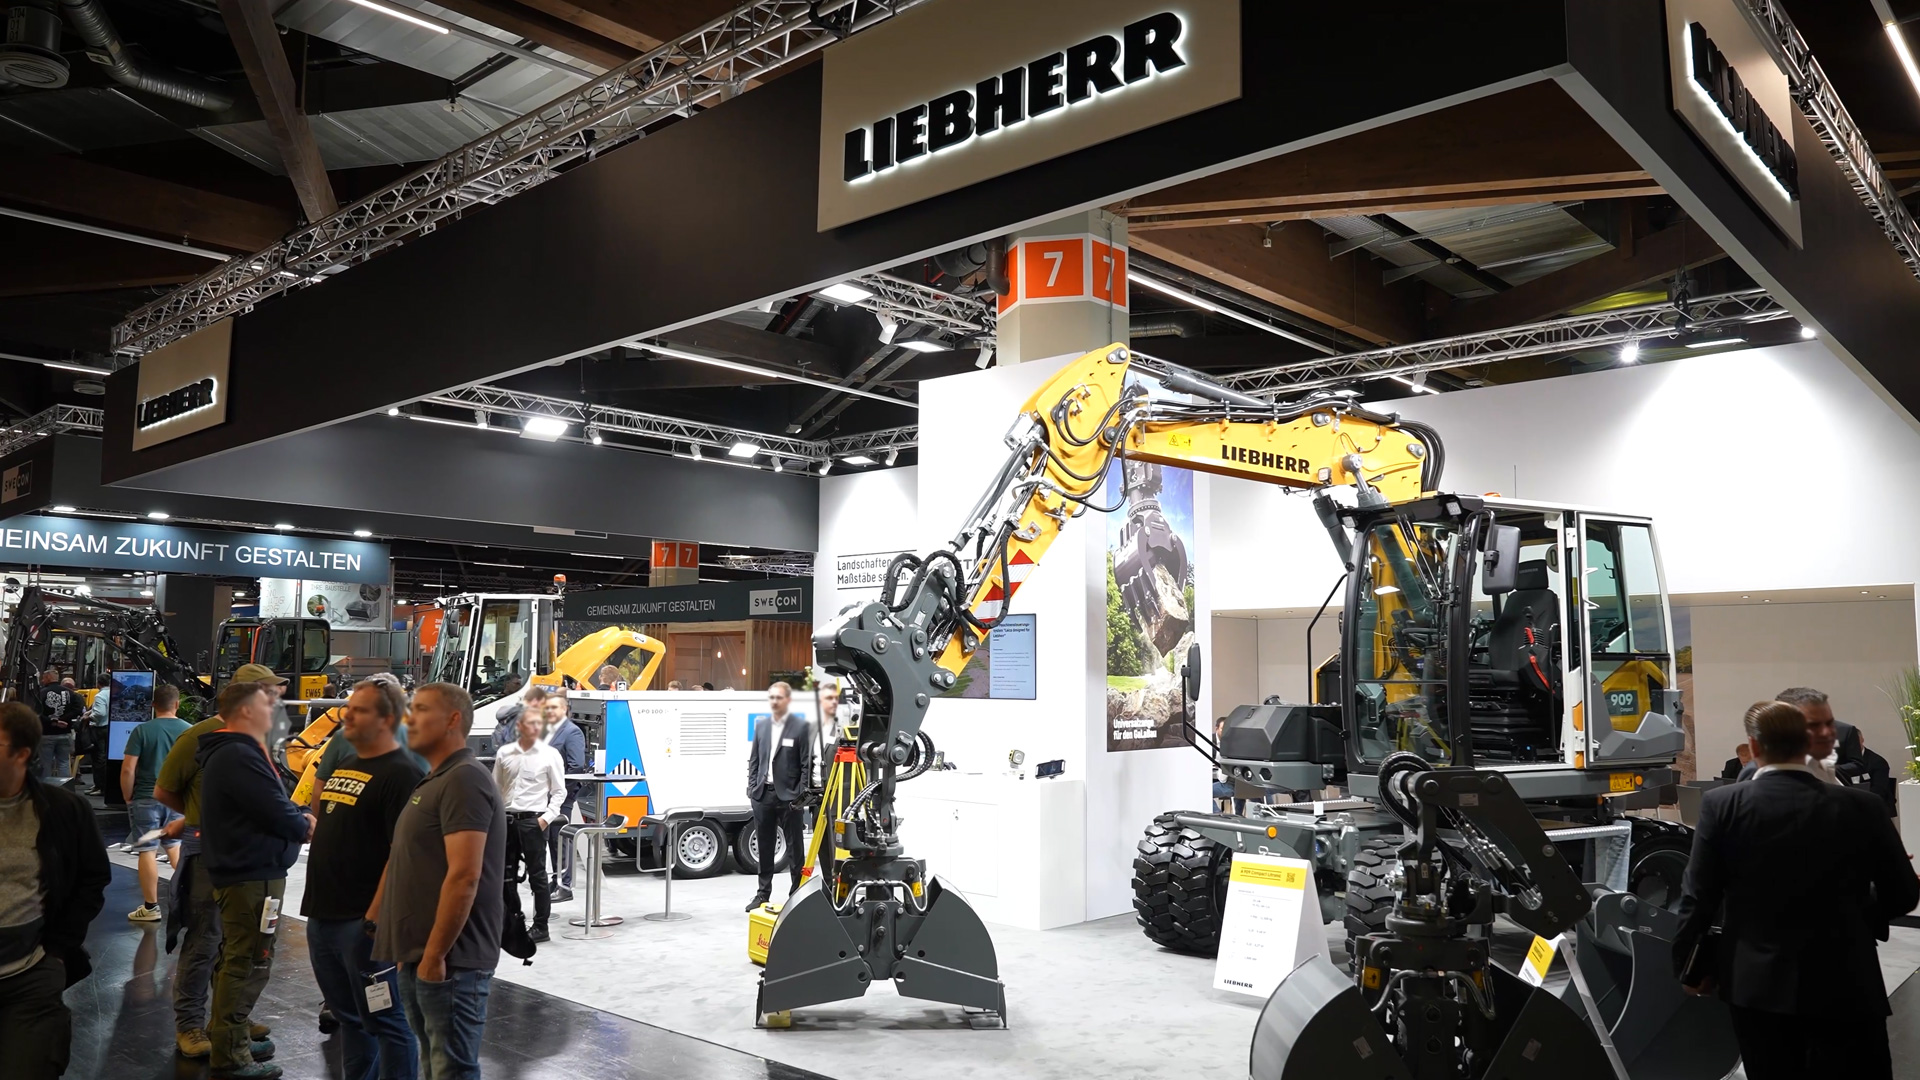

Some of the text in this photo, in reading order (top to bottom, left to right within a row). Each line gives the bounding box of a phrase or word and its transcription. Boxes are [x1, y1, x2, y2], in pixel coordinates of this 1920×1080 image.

[844, 12, 1186, 182] LIEBHERR
[1043, 251, 1063, 287] 7
[1103, 255, 1115, 291] 7
[137, 378, 214, 430] LIEBHERR
[1221, 445, 1310, 475] LIEBHERR
[0, 528, 360, 570] EINSAM ZUKUNFT GESTALTEN
[661, 546, 670, 563] 7
[685, 547, 692, 563] 7
[837, 557, 892, 570] Landschaften
[837, 571, 877, 584] Maßstäbe
[586, 599, 716, 617] GEMEINSAM ZUKUNFT GESTALTEN
[754, 596, 797, 607] SWECON
[73, 620, 105, 629] VOLVO
[305, 688, 321, 698] EW65
[1610, 693, 1633, 706] 909
[1223, 979, 1253, 989] LIEBHERR
